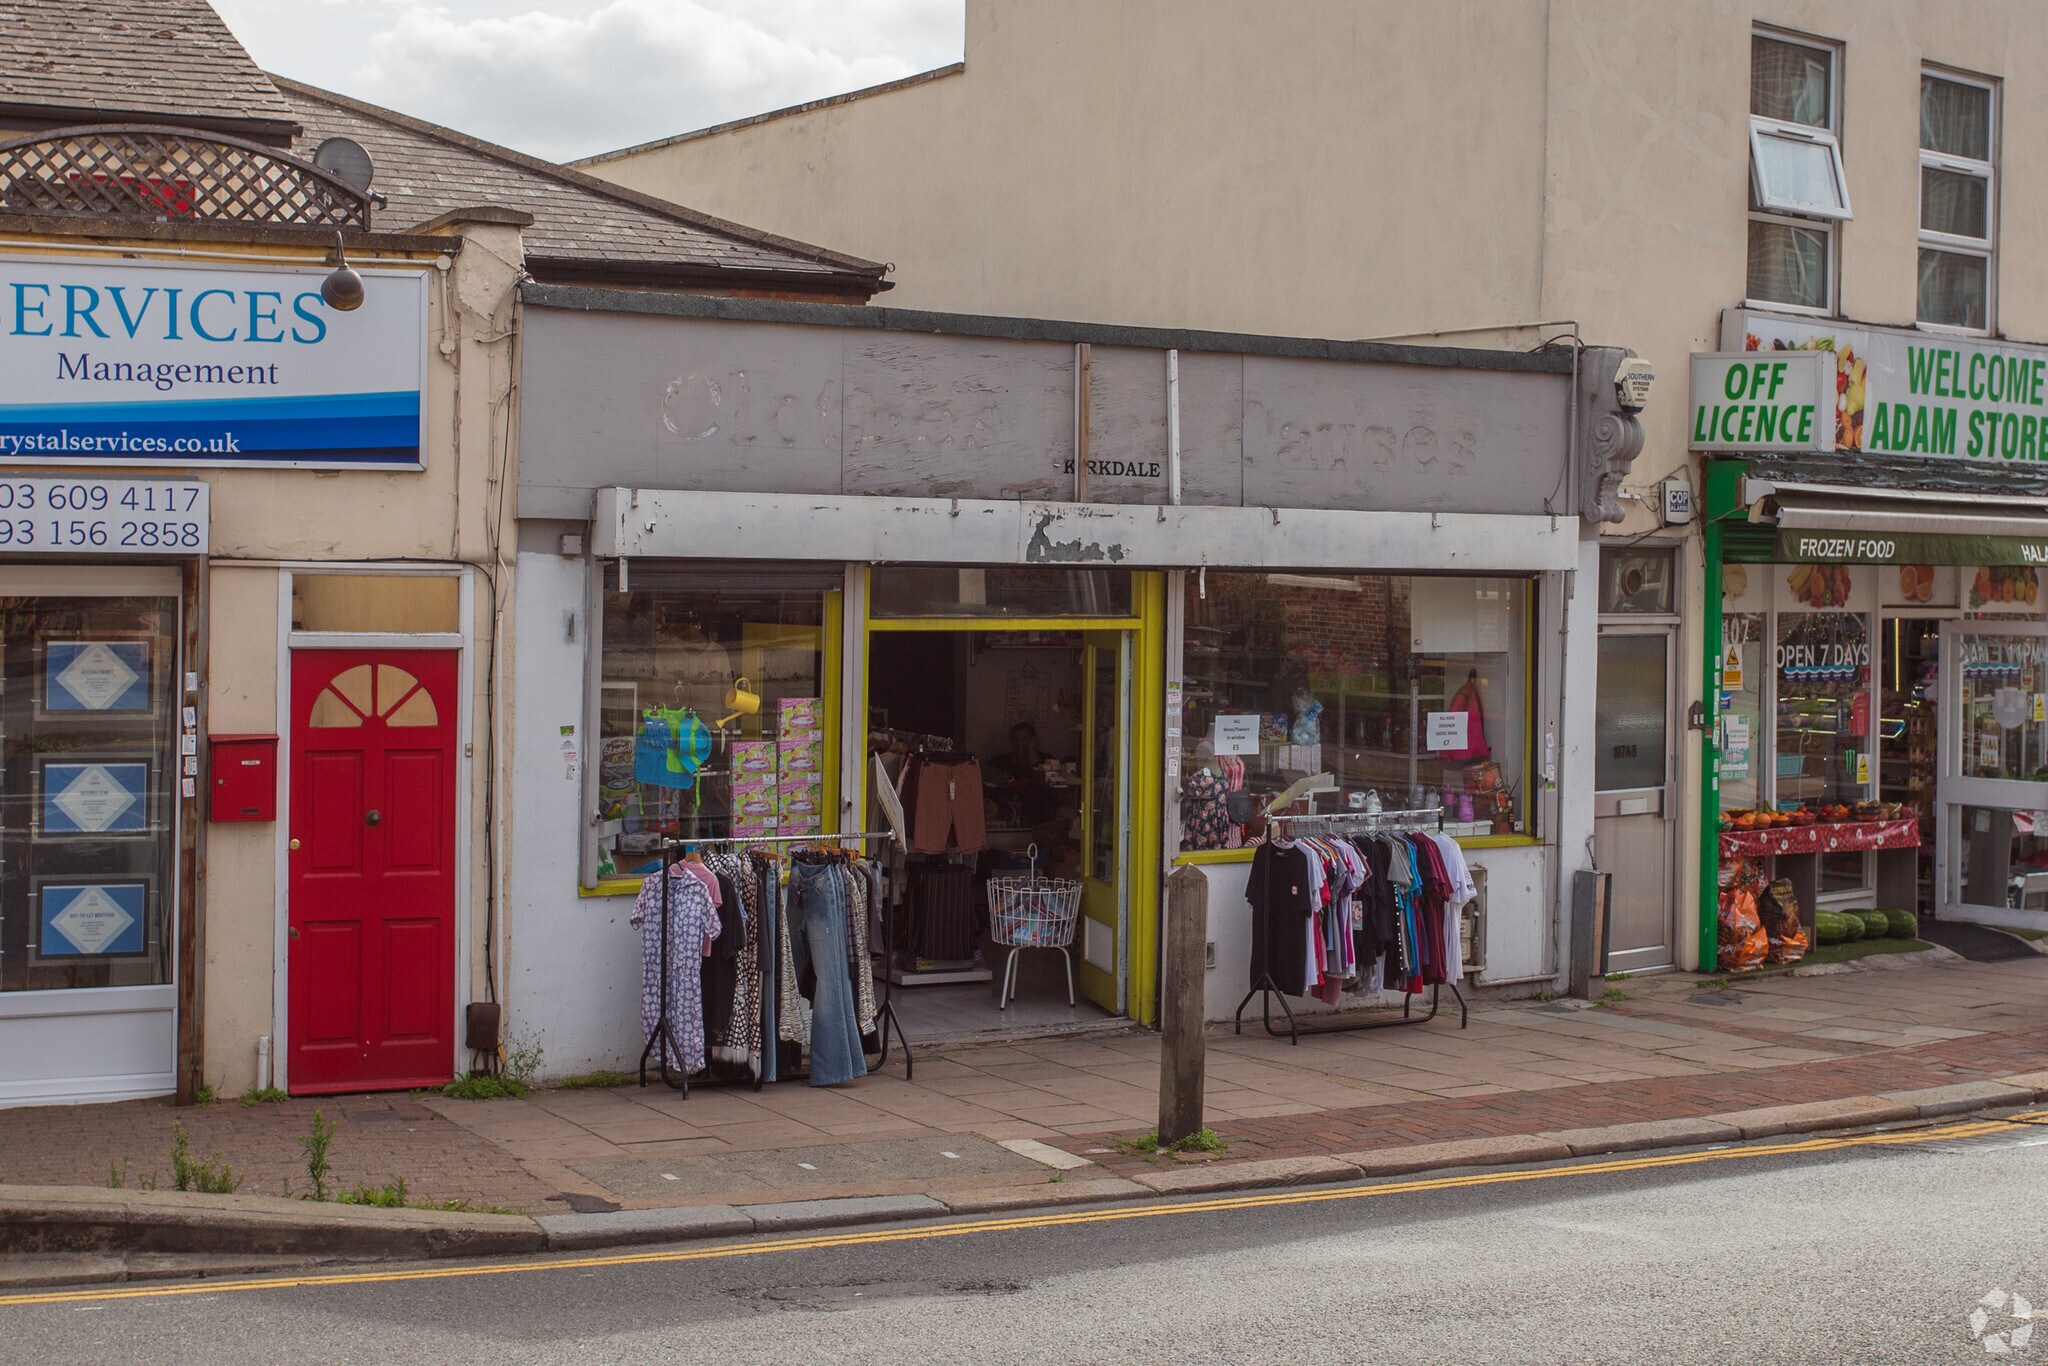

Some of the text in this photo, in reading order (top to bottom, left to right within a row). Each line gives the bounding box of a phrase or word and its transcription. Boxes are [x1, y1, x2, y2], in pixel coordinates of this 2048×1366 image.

[0, 283, 327, 345] ERVICES
[57, 352, 280, 391] Management
[1724, 363, 1787, 400] OFF
[1908, 346, 2046, 406] WELCOME
[1694, 405, 1815, 442] LICENCE
[1869, 402, 1957, 455] ADAM
[1063, 460, 1161, 477] KRKDALE
[48, 485, 108, 510] 609
[120, 487, 200, 512] 4117
[1670, 491, 1688, 504] COP
[51, 521, 108, 546] 156
[120, 521, 200, 547] 2858
[1800, 539, 1895, 558] FROZEN FOOD
[1776, 644, 1870, 668] OPEN 7 DAYS
[1232, 743, 1240, 751] £5
